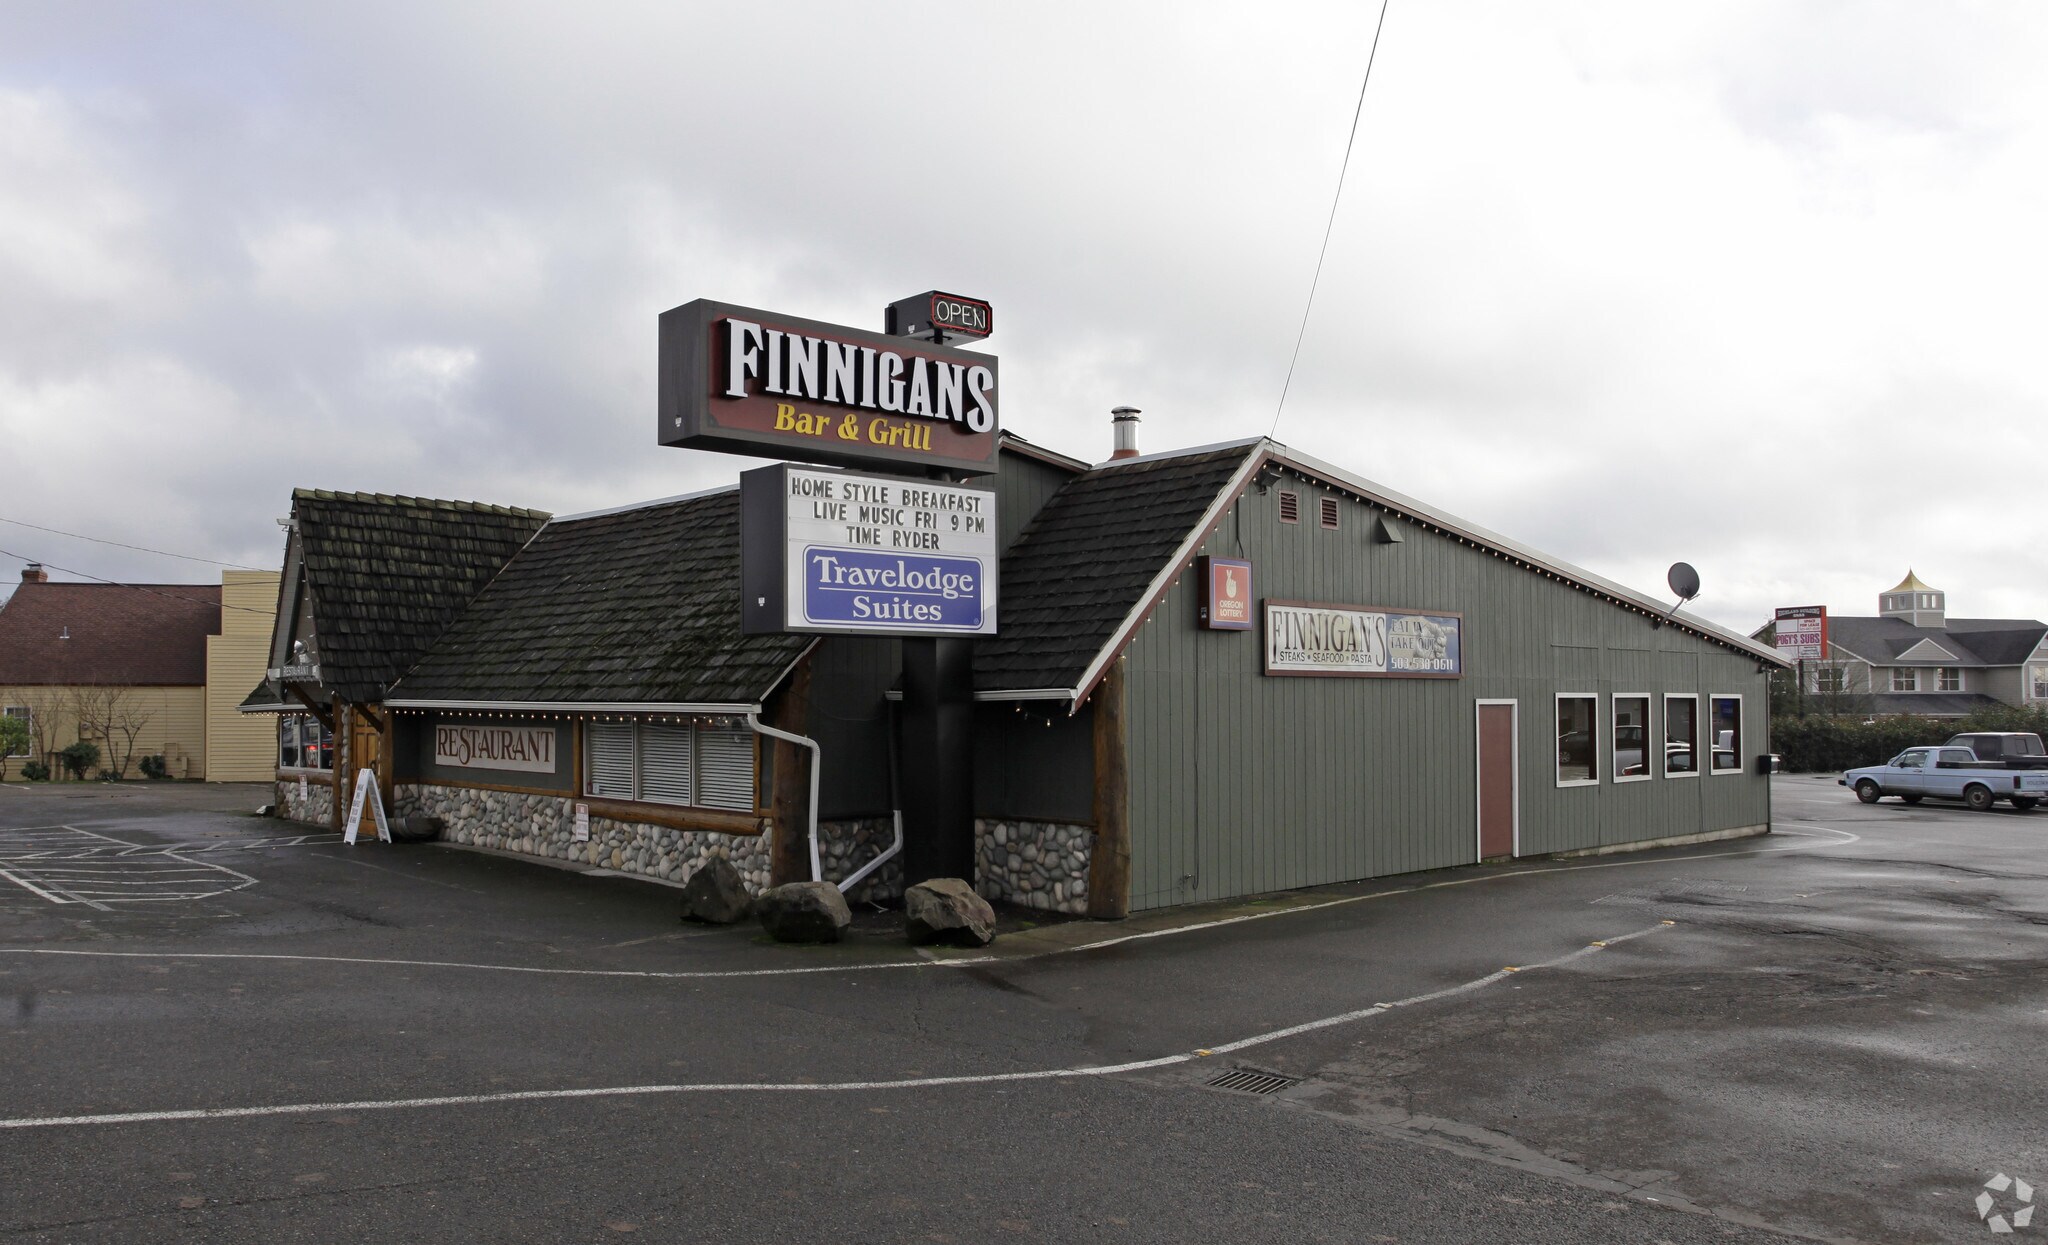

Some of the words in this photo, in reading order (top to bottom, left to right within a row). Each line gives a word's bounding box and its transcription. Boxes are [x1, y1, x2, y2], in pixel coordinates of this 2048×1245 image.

[936, 301, 986, 329] OPEN
[726, 317, 995, 433] FINNIGANS
[774, 403, 830, 436] Bar
[837, 413, 860, 441] &
[868, 418, 932, 451] Grill
[791, 477, 833, 498] HOME
[843, 483, 889, 504] STYLE
[902, 489, 981, 513] BREAKFAST
[813, 502, 847, 521] LIVE
[859, 506, 905, 526] MUSIC
[915, 511, 938, 529] FRI
[951, 514, 959, 531] 9
[966, 516, 985, 533] PM
[847, 526, 881, 545] TIME
[892, 530, 940, 550] RYDER
[813, 555, 974, 600] Travelodge
[853, 596, 942, 621] Suites
[1219, 600, 1244, 609] OREGON
[1220, 608, 1243, 618] LOTTERY
[1271, 611, 1386, 667] FINNIGAN'S
[1392, 619, 1409, 632] EAT
[1413, 621, 1423, 633] IN
[1800, 633, 1820, 644] SUBS
[1391, 636, 1414, 649] TAKE
[1418, 637, 1435, 650] OUT
[1280, 651, 1305, 661] STEAKS
[1312, 652, 1344, 663] SEAFOOD
[1351, 654, 1372, 664] PASTA
[437, 727, 554, 765] RESTAURANT
